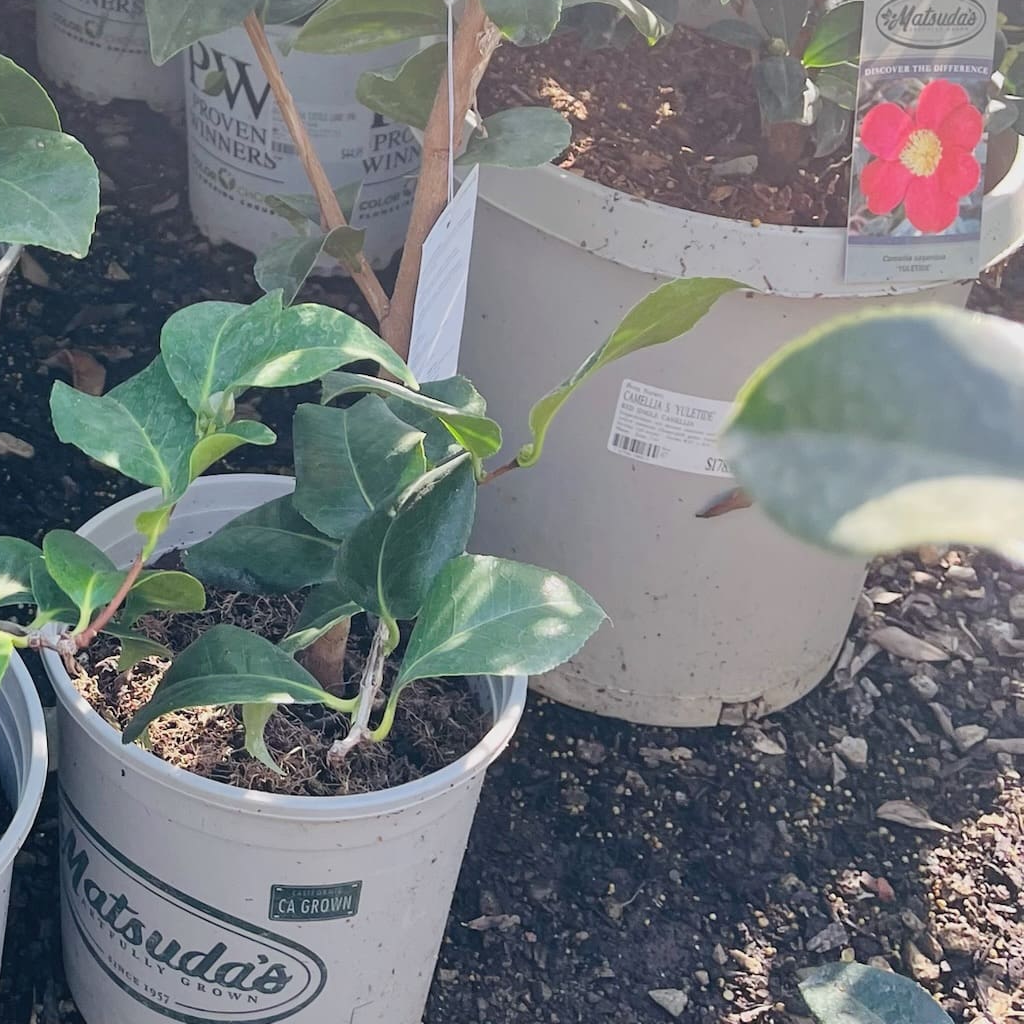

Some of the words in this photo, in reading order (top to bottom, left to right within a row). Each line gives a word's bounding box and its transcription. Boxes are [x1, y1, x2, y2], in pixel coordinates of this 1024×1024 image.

[888, 4, 976, 32] Matsuda's
[864, 63, 910, 76] DISCOVER
[913, 64, 932, 74] THE
[934, 64, 988, 75] DIFFERENCE
[192, 93, 267, 145] PROVEN
[190, 116, 276, 170] WINNERS
[362, 145, 420, 174] WINN
[373, 126, 416, 153] PRO
[62, 828, 293, 994] Matsuda's
[278, 898, 296, 914] CA
[300, 895, 353, 914] GROWN
[81, 896, 167, 975] ARTFULLY
[180, 976, 259, 1005] GROWN
[107, 954, 141, 987] SINCE
[143, 983, 171, 1005] 1957
